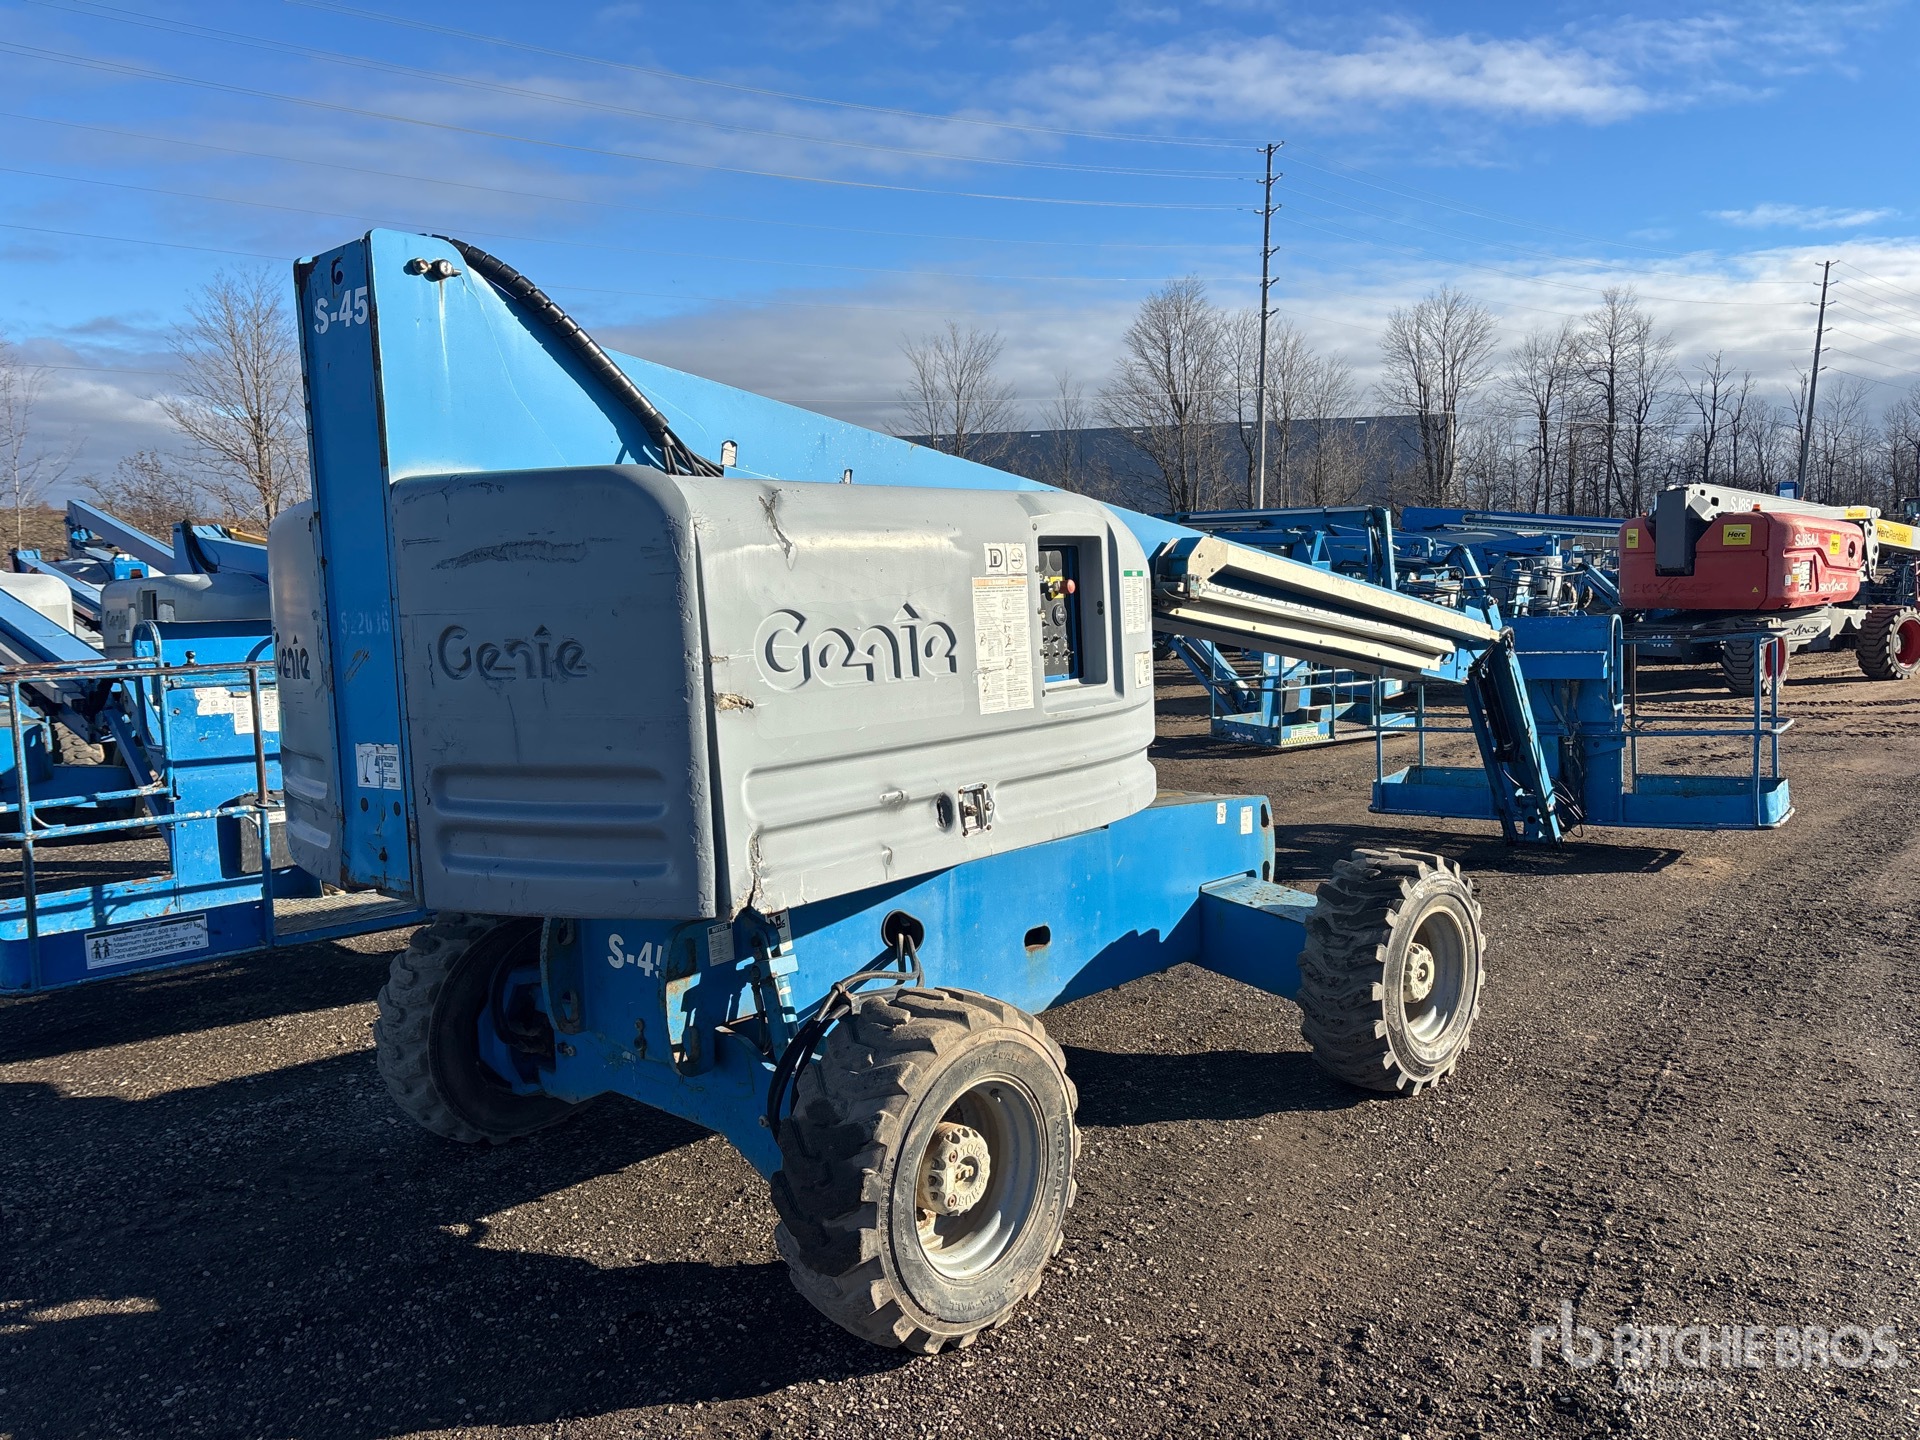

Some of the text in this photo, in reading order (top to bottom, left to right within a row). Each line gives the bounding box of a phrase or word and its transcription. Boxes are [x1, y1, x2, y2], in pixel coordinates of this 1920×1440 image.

[313, 286, 368, 335] S-45
[1795, 533, 1819, 546] SJ85AJ
[1820, 578, 1848, 593] SKYJACK
[437, 624, 589, 681] Genie
[753, 602, 958, 693] Genie
[711, 919, 728, 934] NOTICE
